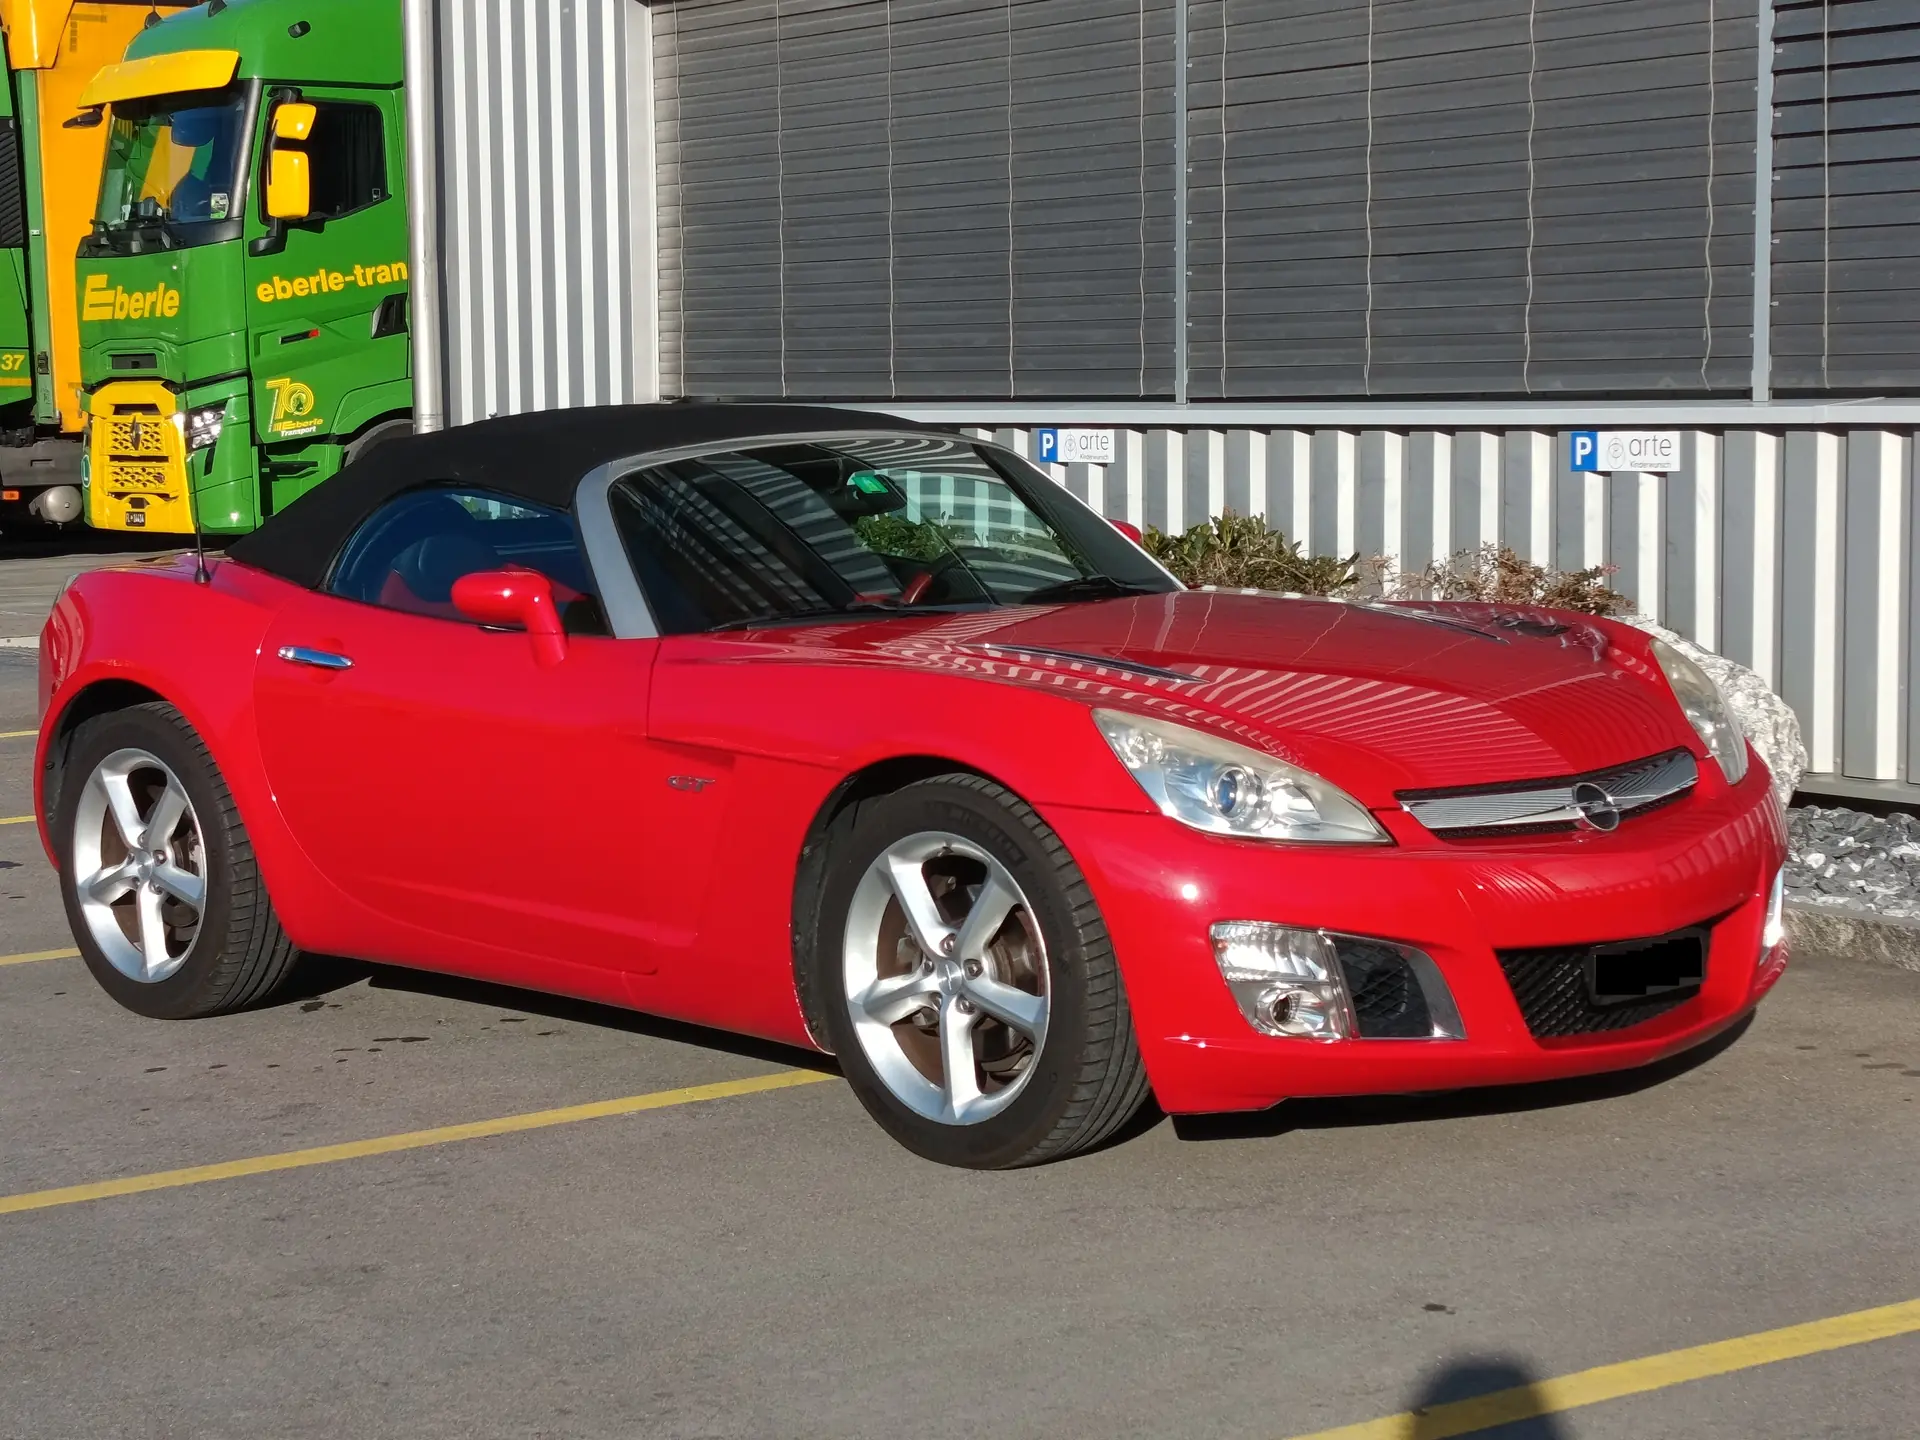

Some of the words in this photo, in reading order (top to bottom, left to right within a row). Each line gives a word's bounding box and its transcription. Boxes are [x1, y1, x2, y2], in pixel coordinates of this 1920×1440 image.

[257, 262, 408, 302] eberle-tran
[83, 274, 180, 321] Eberle
[1, 354, 25, 371] 37
[280, 426, 317, 437] Transport
[281, 418, 324, 433] Eberle
[1042, 433, 1054, 457] P
[1079, 432, 1109, 450] arte
[1629, 435, 1672, 456] arte
[1575, 436, 1592, 466] P
[668, 775, 715, 792] GT
